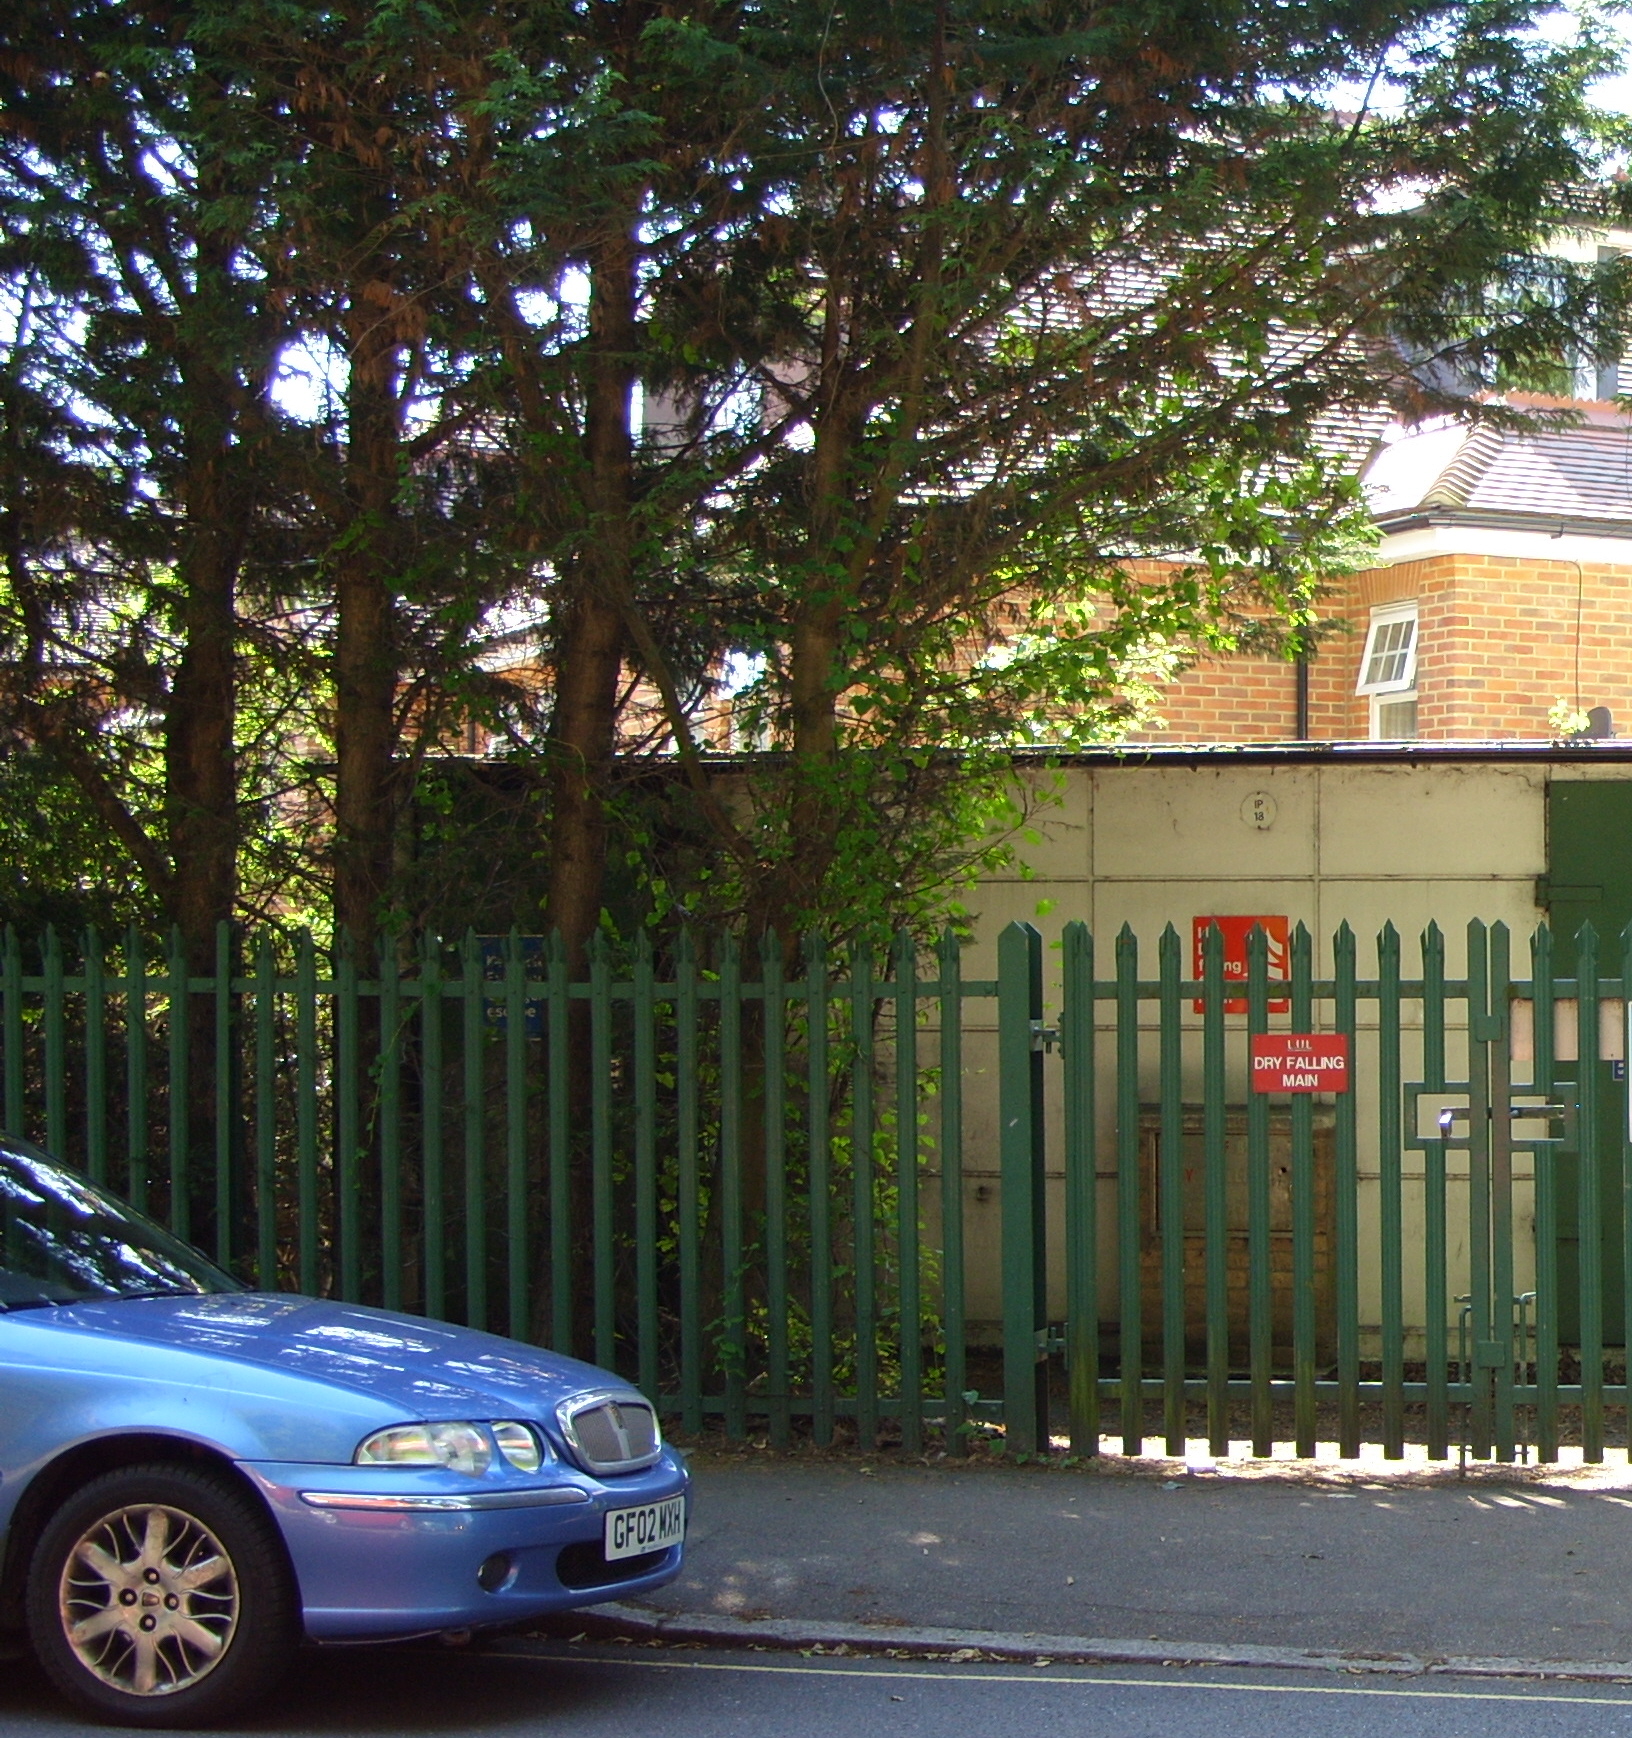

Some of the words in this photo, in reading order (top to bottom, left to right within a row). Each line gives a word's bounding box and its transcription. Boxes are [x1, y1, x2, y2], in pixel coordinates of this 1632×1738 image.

[1254, 1056, 1282, 1070] DRY
[1286, 1056, 1345, 1070] FALLING
[1282, 1074, 1318, 1087] MAIN
[614, 1508, 656, 1550] GF02
[659, 1501, 681, 1539] MXH
